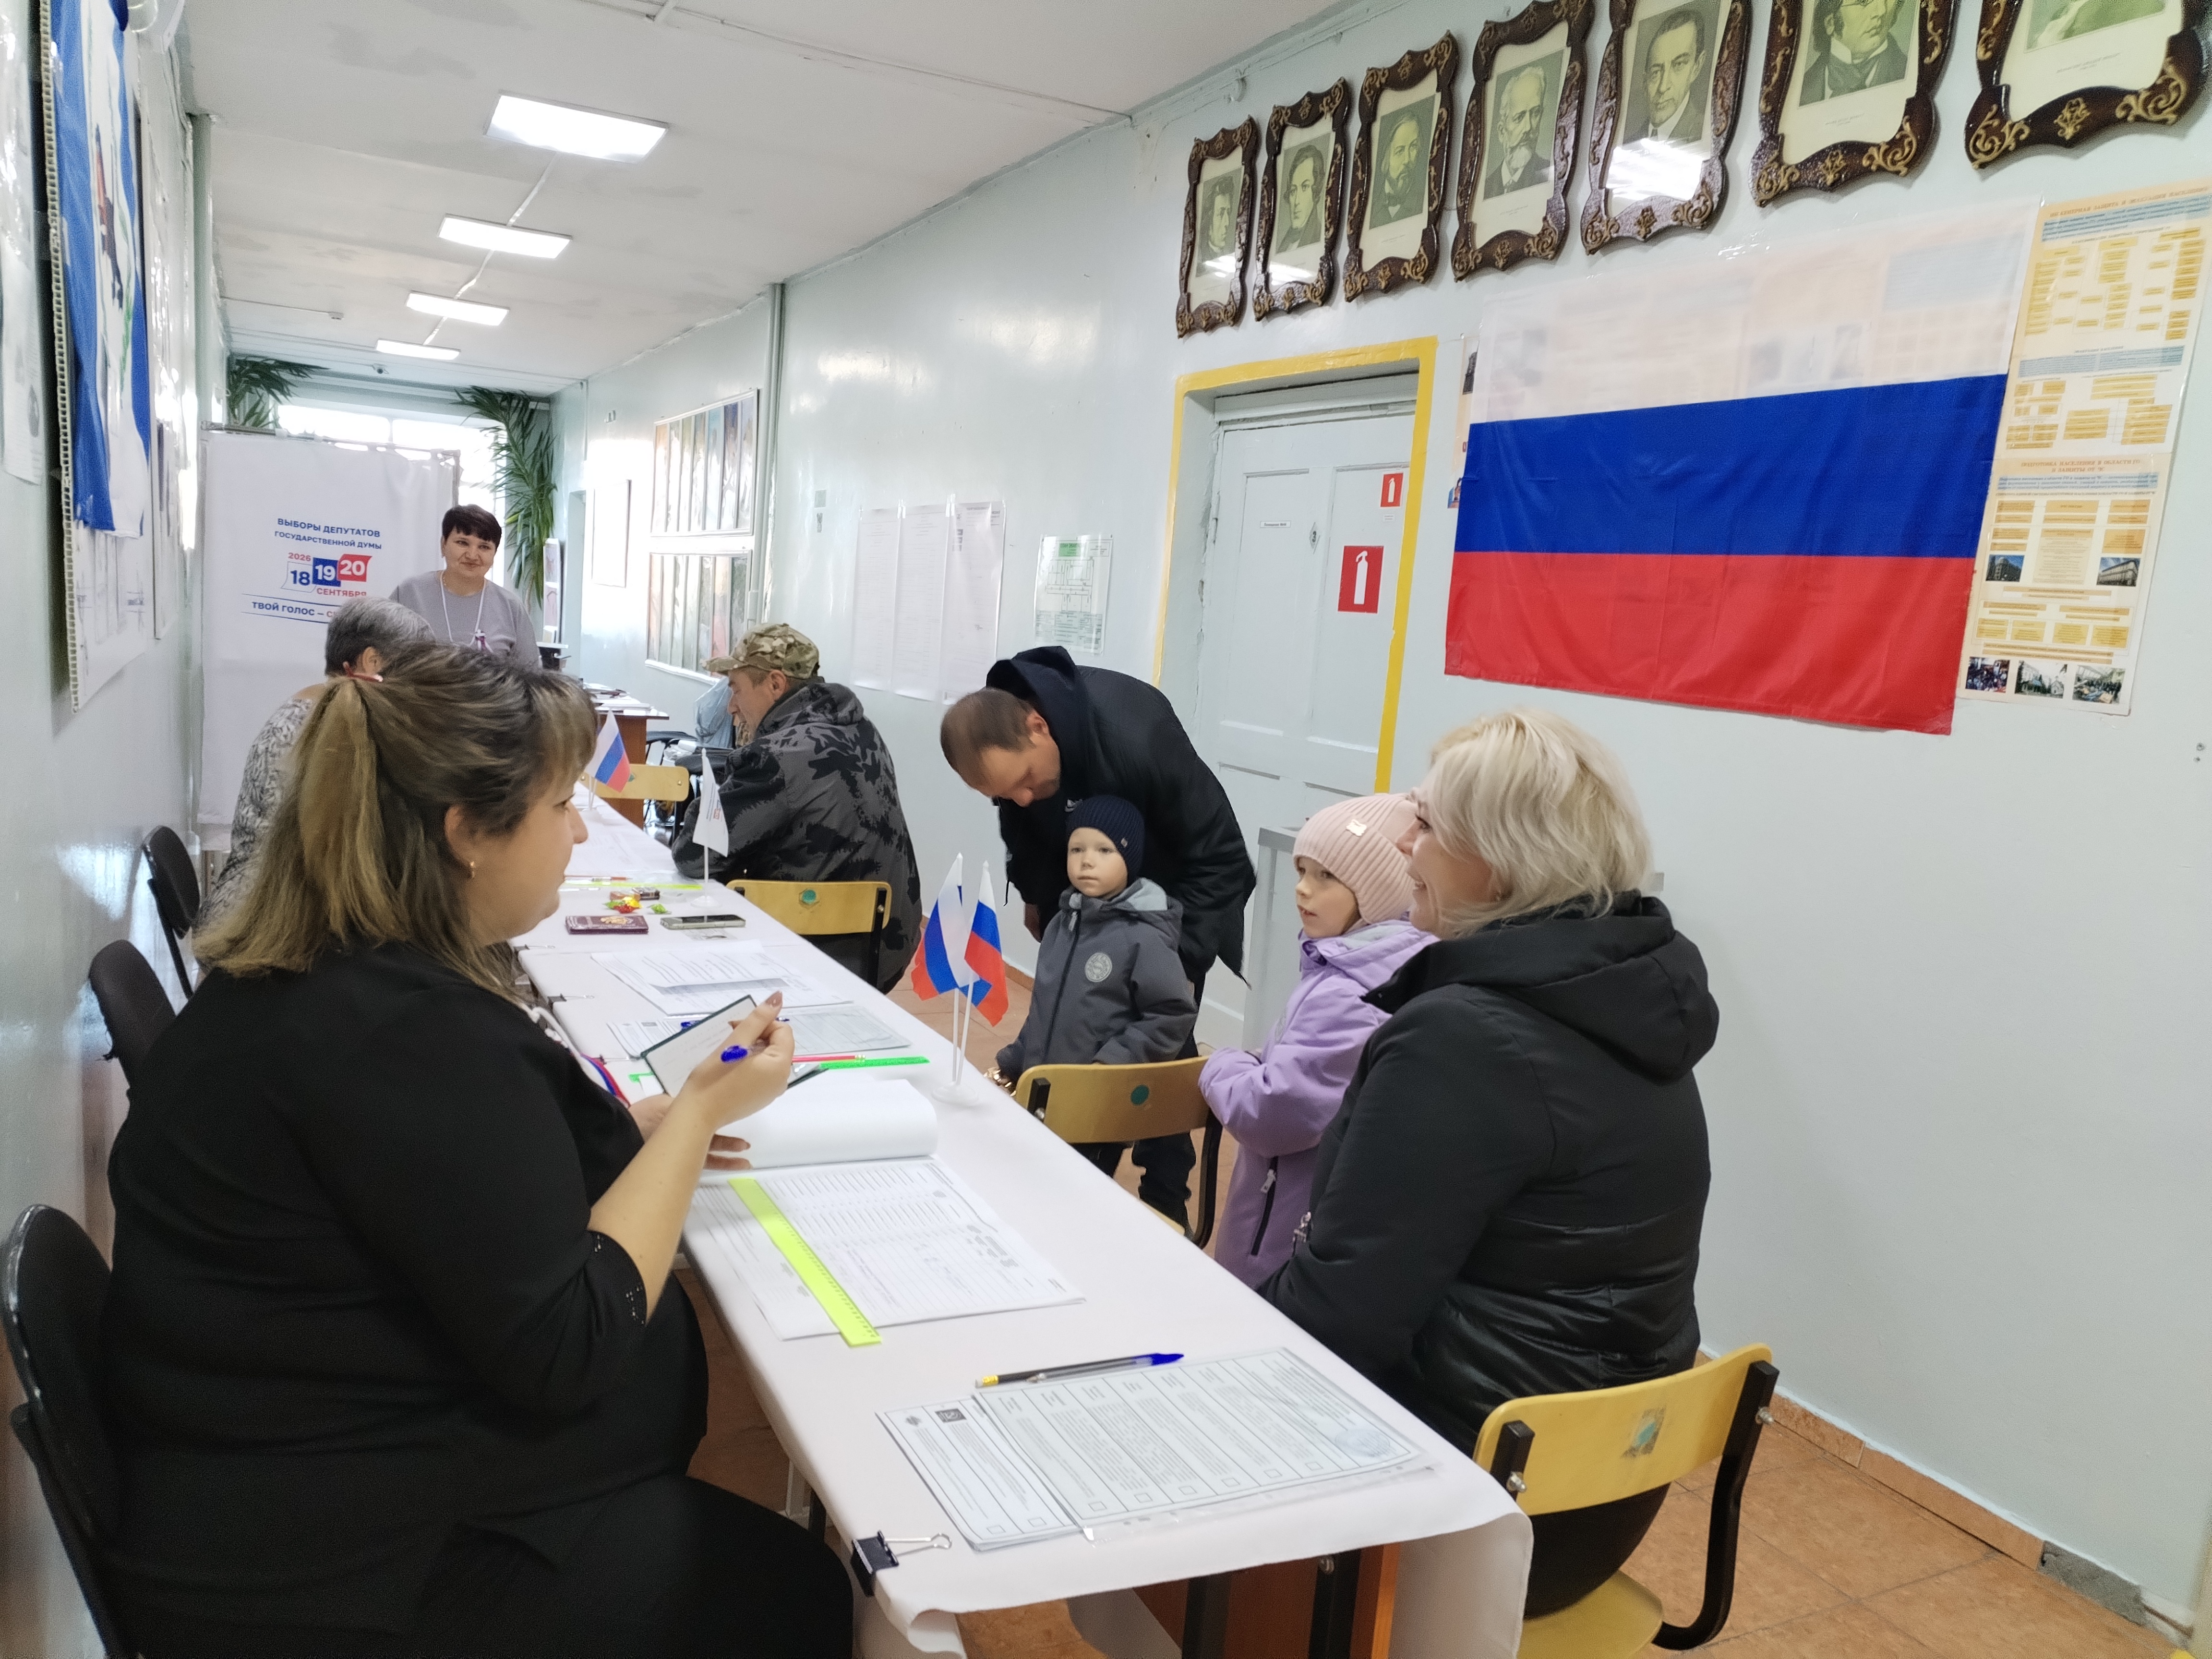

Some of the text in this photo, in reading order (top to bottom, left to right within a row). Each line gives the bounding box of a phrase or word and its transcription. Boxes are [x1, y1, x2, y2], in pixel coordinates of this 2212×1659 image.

[277, 518, 380, 537] ВЫБОРЫ ДЕПУТАТОВ
[274, 531, 355, 547] ГОСУДАРСТВЕННОЙ
[1312, 530, 1316, 542] 3
[288, 552, 311, 562] 2026
[290, 559, 365, 586] 18 19 20
[252, 601, 279, 611] ТВОЙ
[282, 605, 315, 616] ГОЛОС
